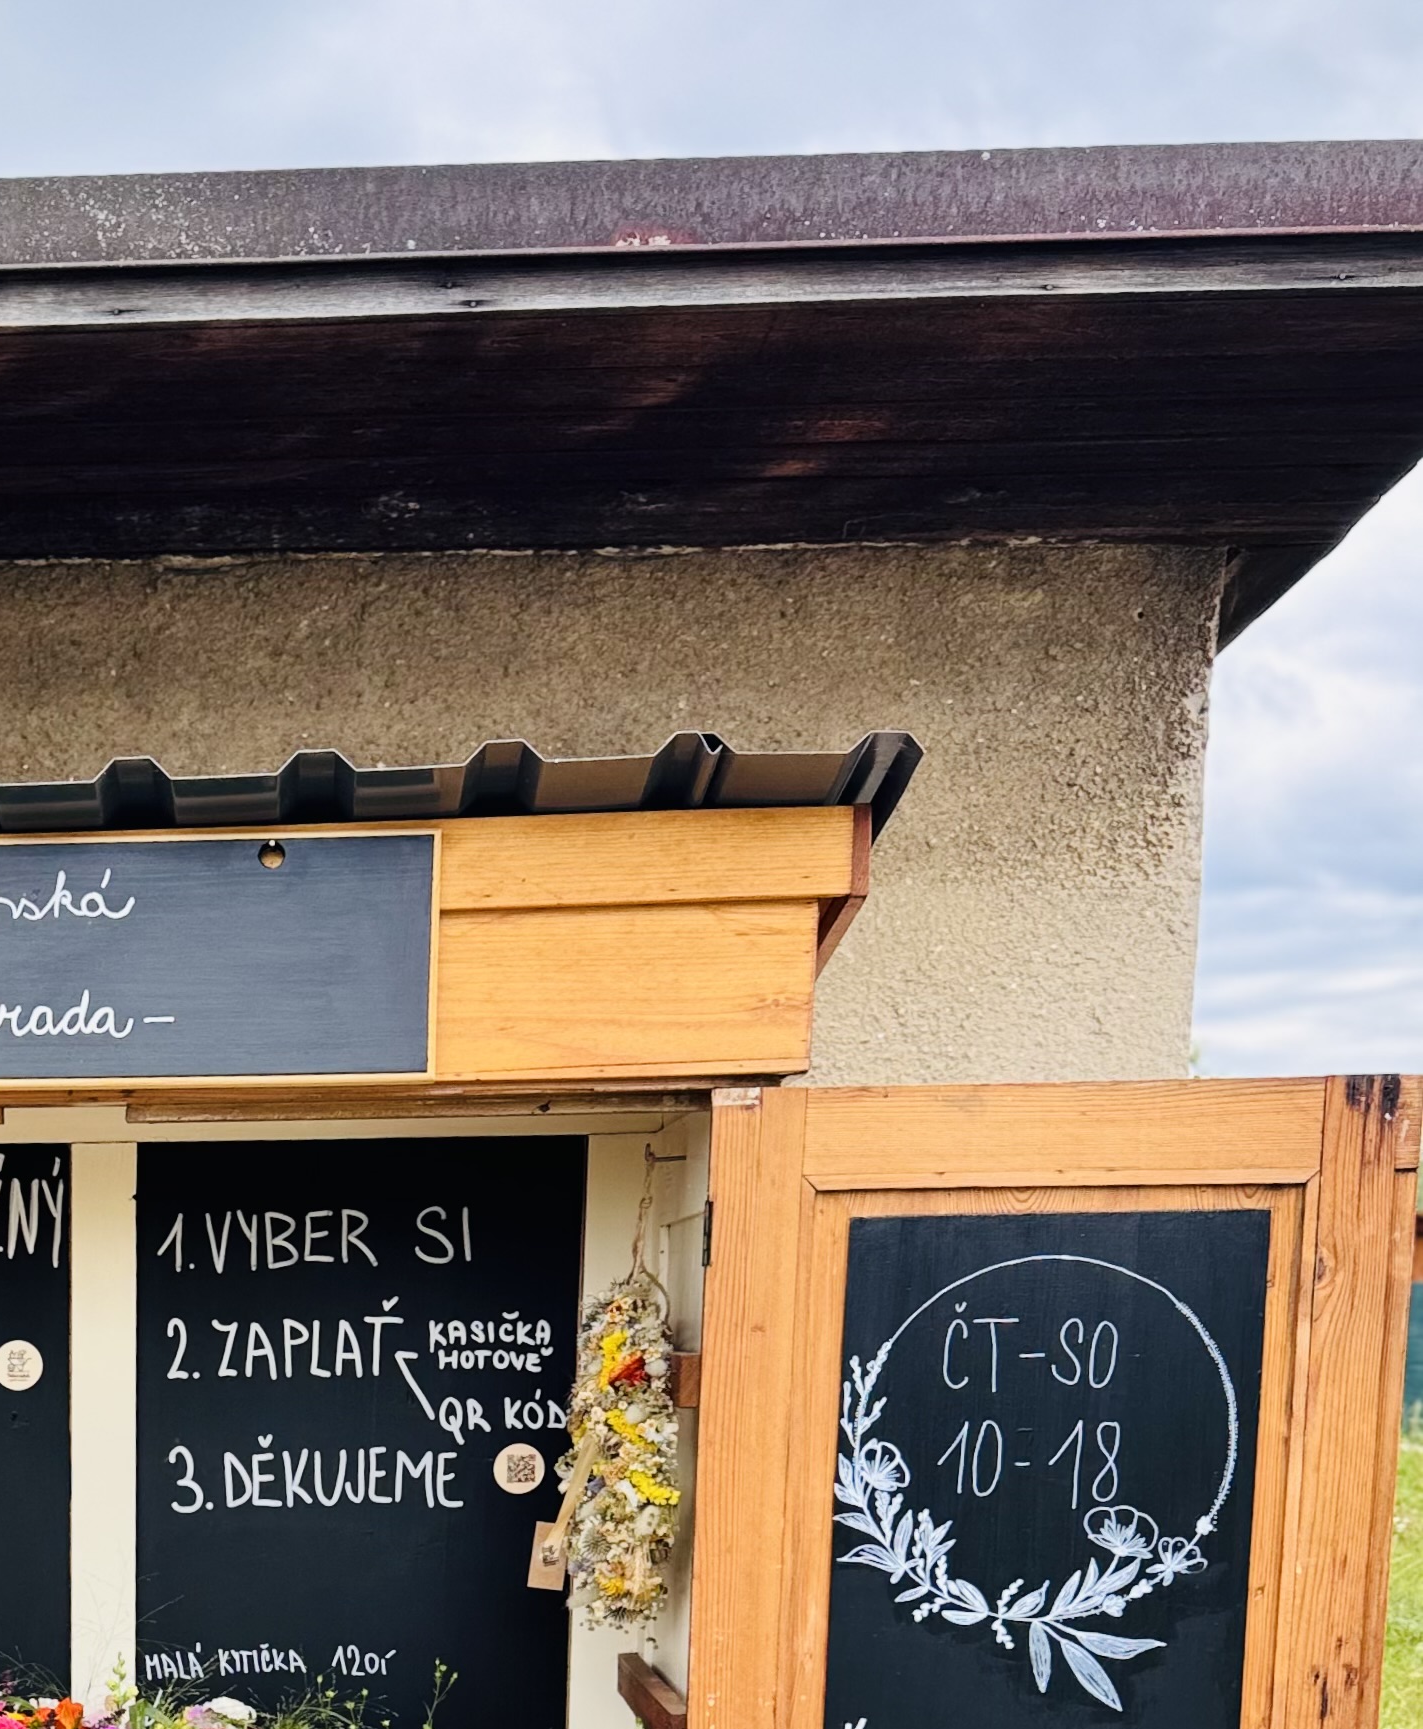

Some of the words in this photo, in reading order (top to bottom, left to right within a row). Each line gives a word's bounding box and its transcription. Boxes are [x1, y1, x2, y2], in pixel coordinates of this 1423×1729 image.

[157, 1213, 194, 1272] 1.
[206, 1209, 378, 1273] VYBER
[415, 1207, 471, 1263] SI
[167, 1318, 200, 1379] 2.
[212, 1296, 404, 1380] ZAPLAŤ
[429, 1311, 553, 1356] KASIČKA
[438, 1347, 553, 1372] HOTOVĚ
[439, 1397, 491, 1445] QR
[504, 1389, 571, 1429] KÓD
[169, 1446, 213, 1513] 3.
[223, 1434, 465, 1508] DĚKUJEME
[145, 1642, 204, 1682] MALÁ
[218, 1644, 306, 1676] KYTIČKA
